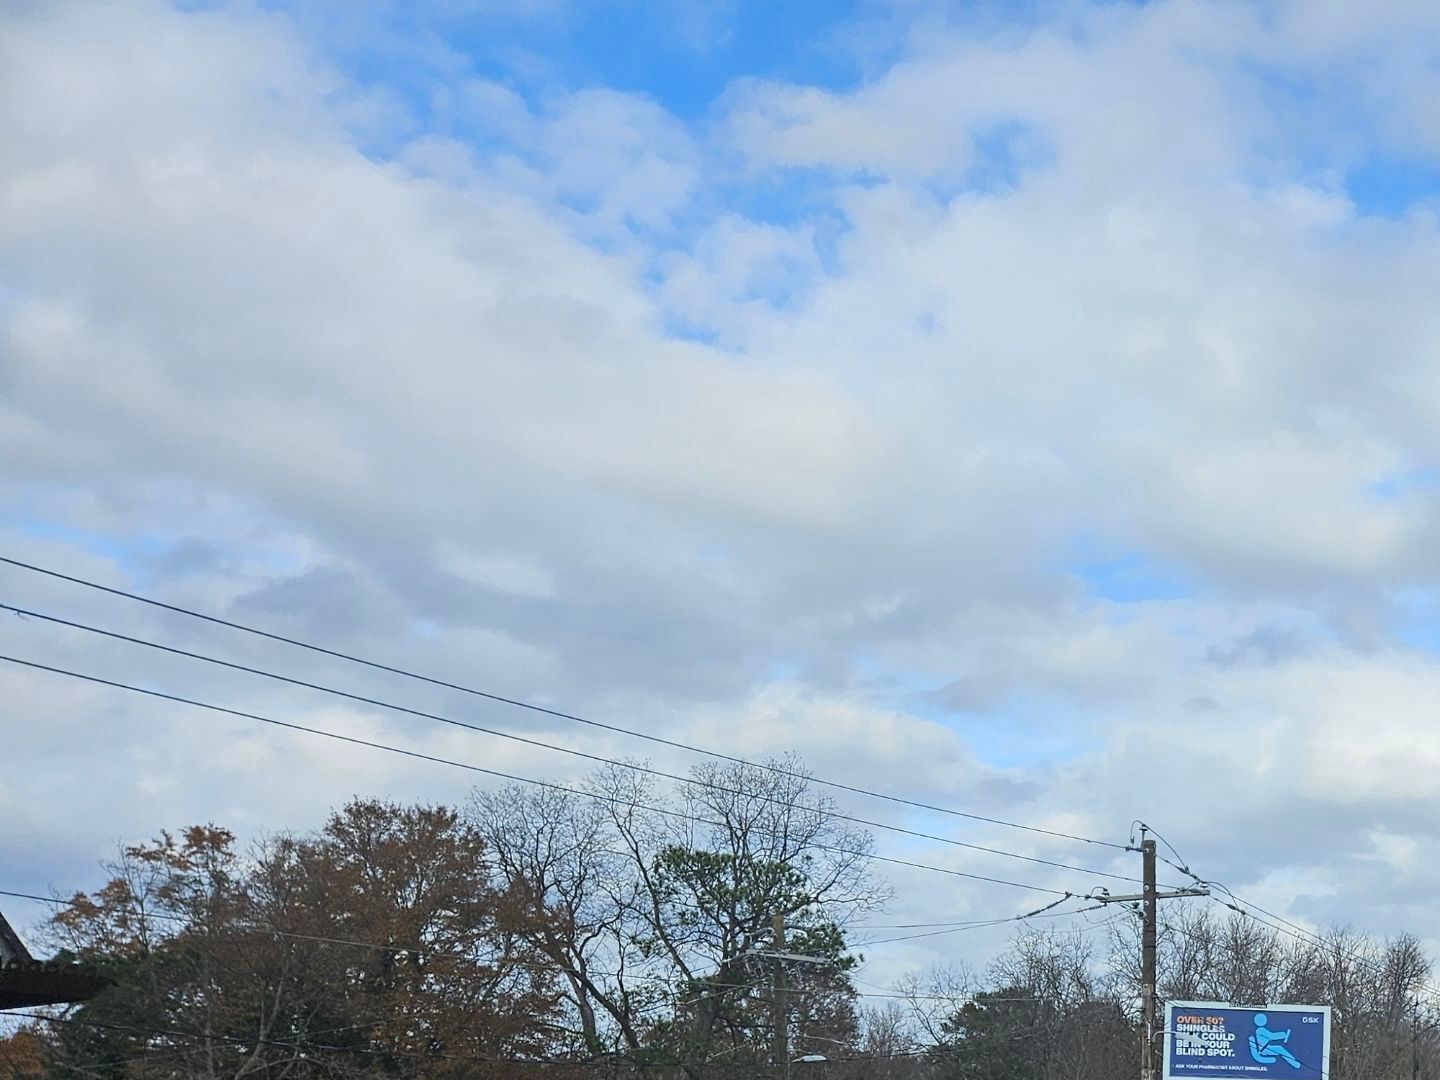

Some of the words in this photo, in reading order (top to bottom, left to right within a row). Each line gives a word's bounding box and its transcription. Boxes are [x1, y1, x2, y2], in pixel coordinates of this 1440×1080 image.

[1177, 1016, 1204, 1024] OVER
[1176, 1024, 1225, 1032] SHINGLES
[1201, 1032, 1235, 1041] COULD
[1176, 1039, 1189, 1047] BE
[1176, 1048, 1205, 1056] BLIND
[1207, 1049, 1235, 1057] SPOT.
